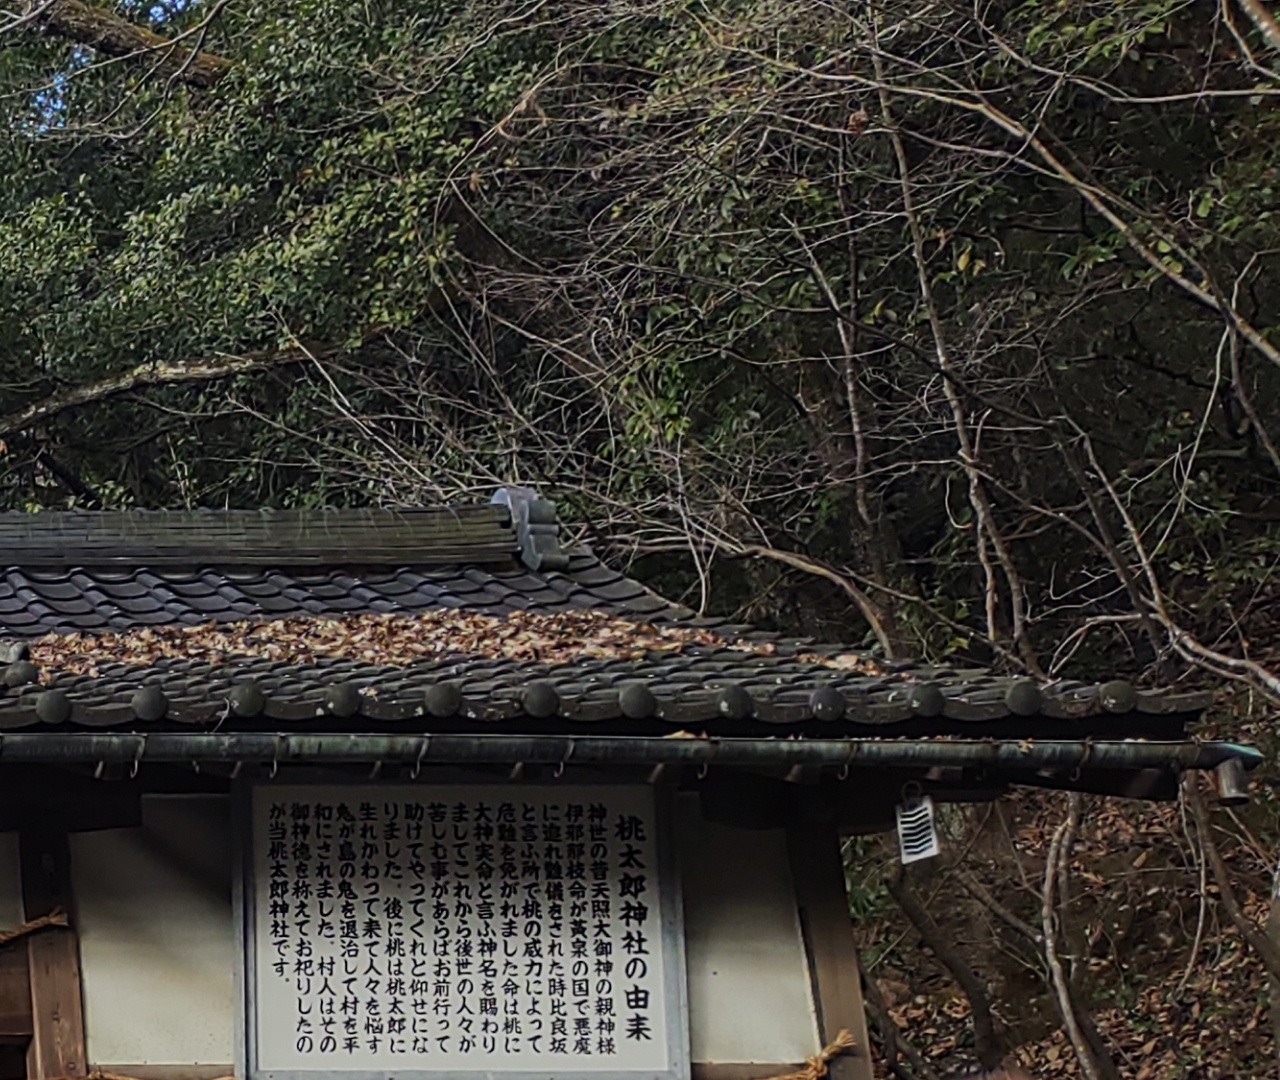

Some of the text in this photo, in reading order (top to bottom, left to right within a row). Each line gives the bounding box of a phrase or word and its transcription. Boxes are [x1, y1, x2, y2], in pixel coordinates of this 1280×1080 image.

[268, 802, 291, 983] が当桃太郎神社です。
[290, 801, 314, 1054] 御神徳を称えてお祀りしたの
[312, 802, 337, 1053] 和にされました。村人はその
[335, 802, 360, 1055] 鬼が島の鬼を退治して村を平
[358, 801, 384, 1055] 生れかわって来て人々を悩す
[381, 801, 407, 1054] りました。後に桃は桃太郎に
[403, 801, 429, 1054] 助けてやってくれと仰せにな
[427, 801, 452, 1053] 苦しむ事があらばお前行って
[450, 801, 476, 1054] ましてこれから後世の人々が
[472, 801, 499, 1054] 大神実命と言ふ神名を賜わり
[496, 801, 522, 1054] 危難を免がれました命は桃に
[519, 801, 543, 1054] と言ふ所で桃の威力によって
[587, 802, 616, 1055] 神世の昔天照大御神の親神様
[615, 813, 650, 1042] 桃太郎神社の由来
